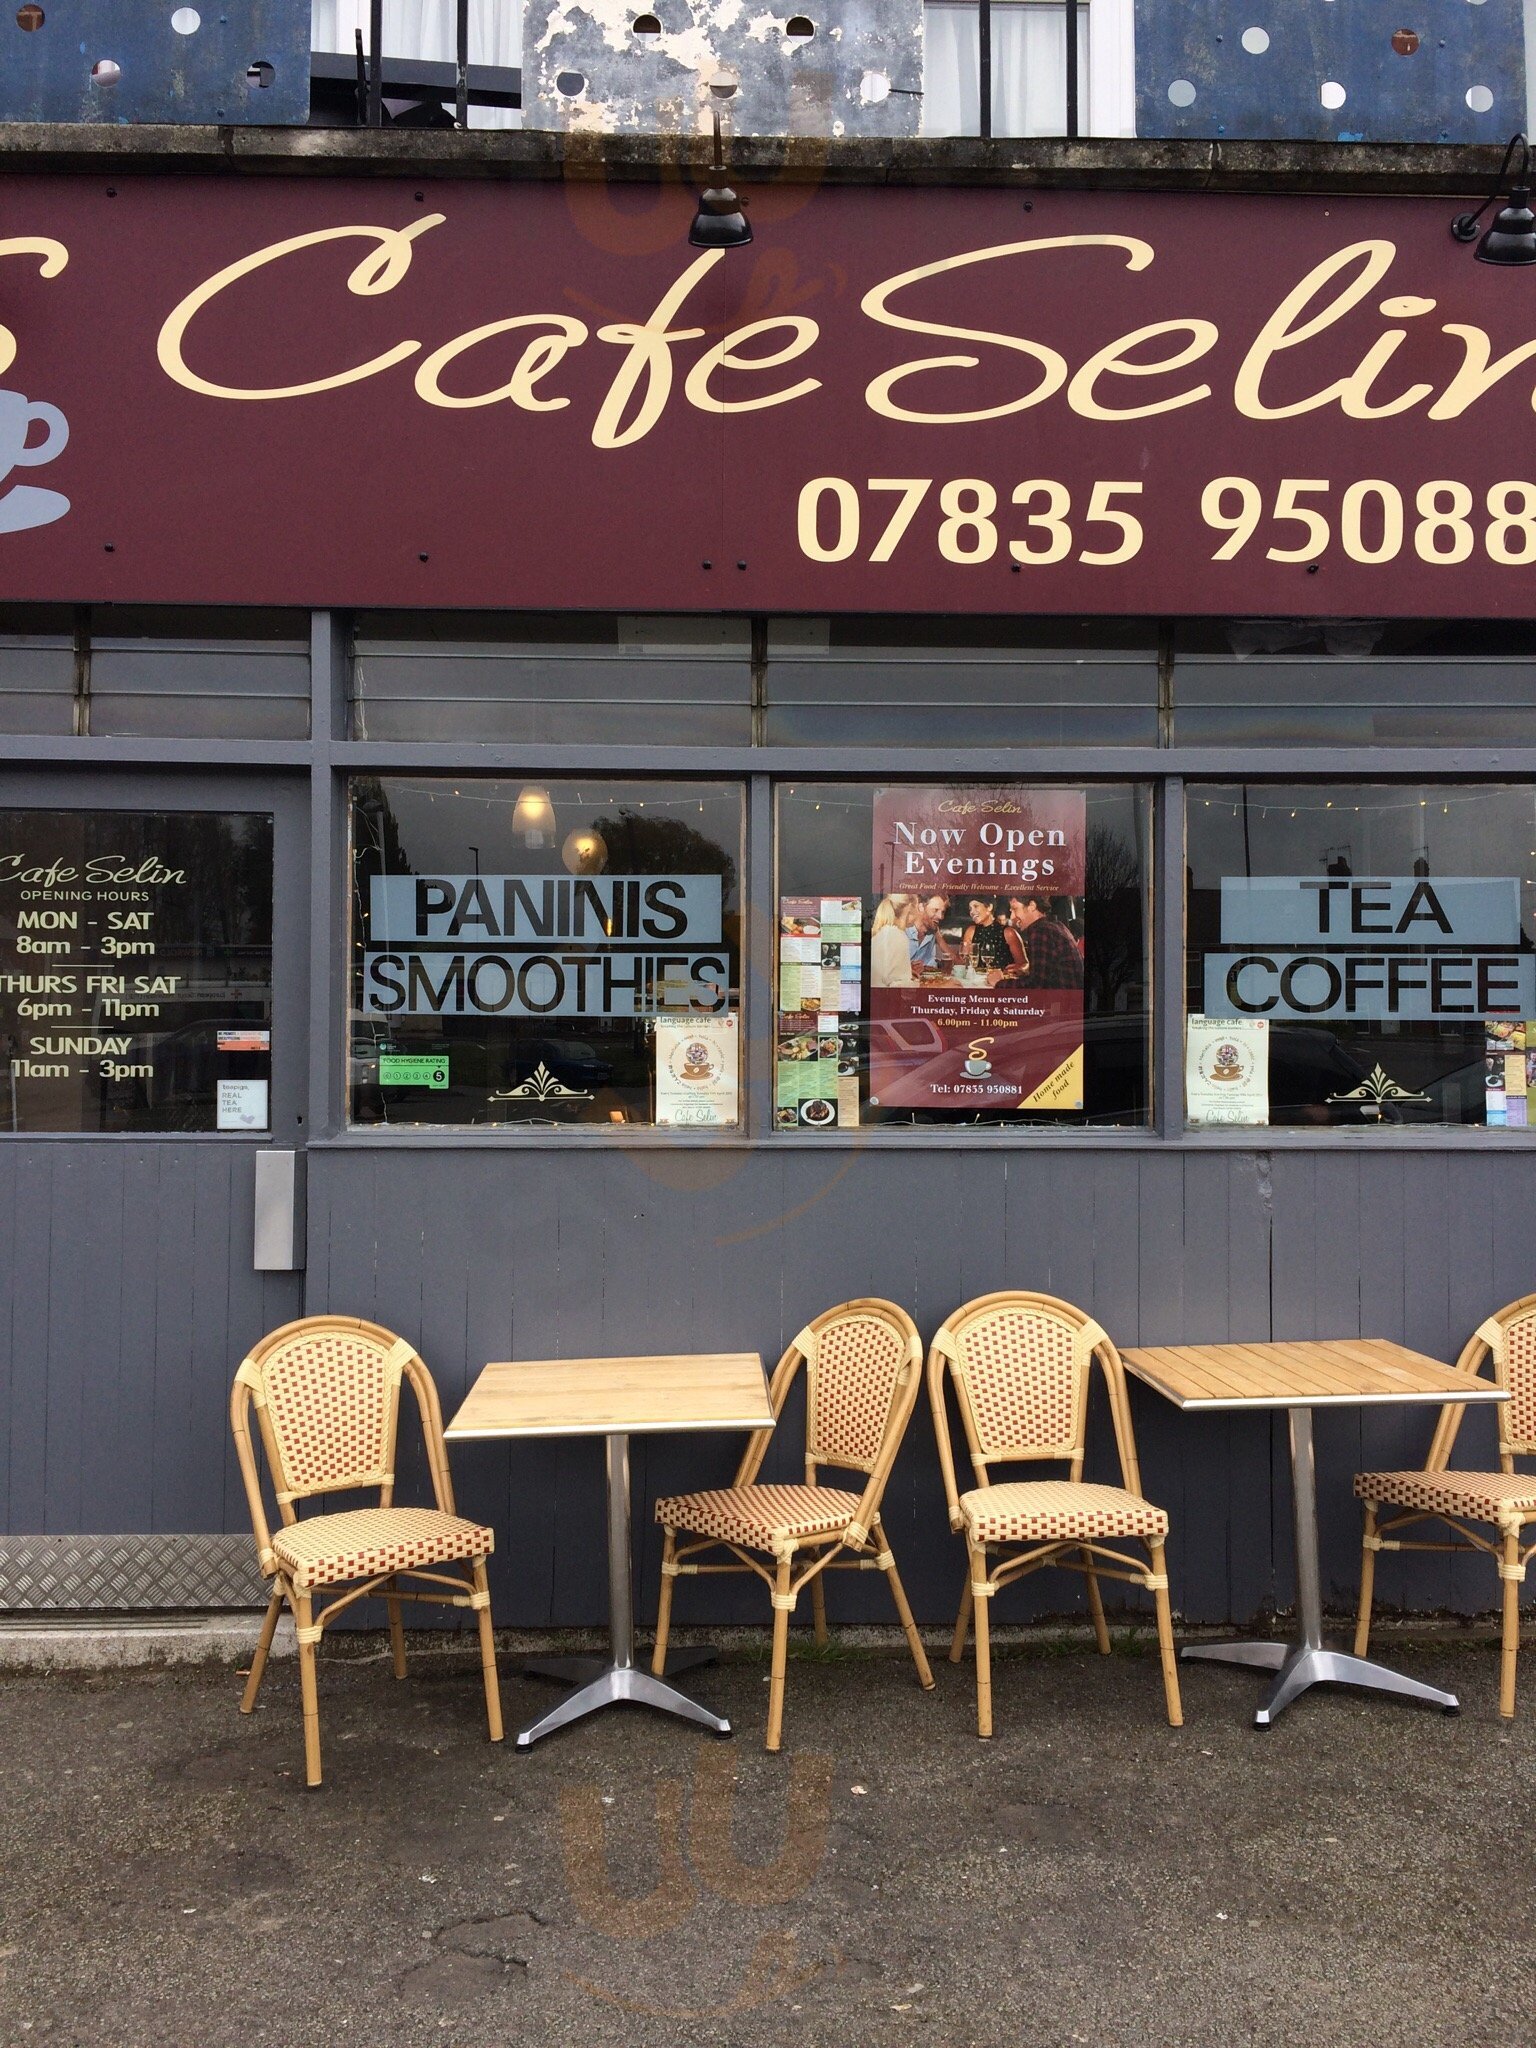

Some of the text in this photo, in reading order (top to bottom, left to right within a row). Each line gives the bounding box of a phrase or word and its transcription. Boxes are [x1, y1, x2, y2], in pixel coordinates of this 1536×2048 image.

[157, 213, 822, 448] Cafe
[861, 234, 1536, 423] Selin
[797, 477, 1536, 565] 07835 95088
[938, 800, 1021, 814] Cafe Selin
[894, 822, 1066, 852] Now Open
[85, 855, 187, 884] Selin
[904, 851, 1055, 881] Evenings
[20, 890, 149, 901] OPENING HOURS
[415, 879, 688, 939] PANINIS
[1300, 882, 1453, 933] TEA
[16, 911, 78, 929] MON
[107, 912, 154, 930] SAT
[16, 935, 71, 954] 8am
[100, 936, 155, 958] 3pm
[87, 976, 125, 994] FRI
[134, 976, 181, 994] SAT
[369, 955, 725, 1013] SMOOTHIES
[1226, 956, 1521, 1014] COFFEE
[17, 998, 72, 1020] 6pm
[101, 999, 159, 1020] 11pm
[928, 995, 1028, 1004] Evening Menu served
[661, 1016, 694, 1024] language
[911, 1006, 1045, 1017] Thursday, Friday & Saturday
[1192, 1018, 1225, 1026] language
[937, 1018, 970, 1027] 6.00pm
[981, 1018, 1018, 1028] 11.00pm
[30, 1037, 132, 1055] SUNDAY
[11, 1059, 69, 1077] 11am
[99, 1060, 153, 1081] 3pm
[435, 1072, 442, 1080] 5
[930, 1084, 951, 1093] Tel:
[986, 1084, 1022, 1094] 950881
[1033, 1062, 1074, 1102] Home made
[1052, 1079, 1069, 1100] food
